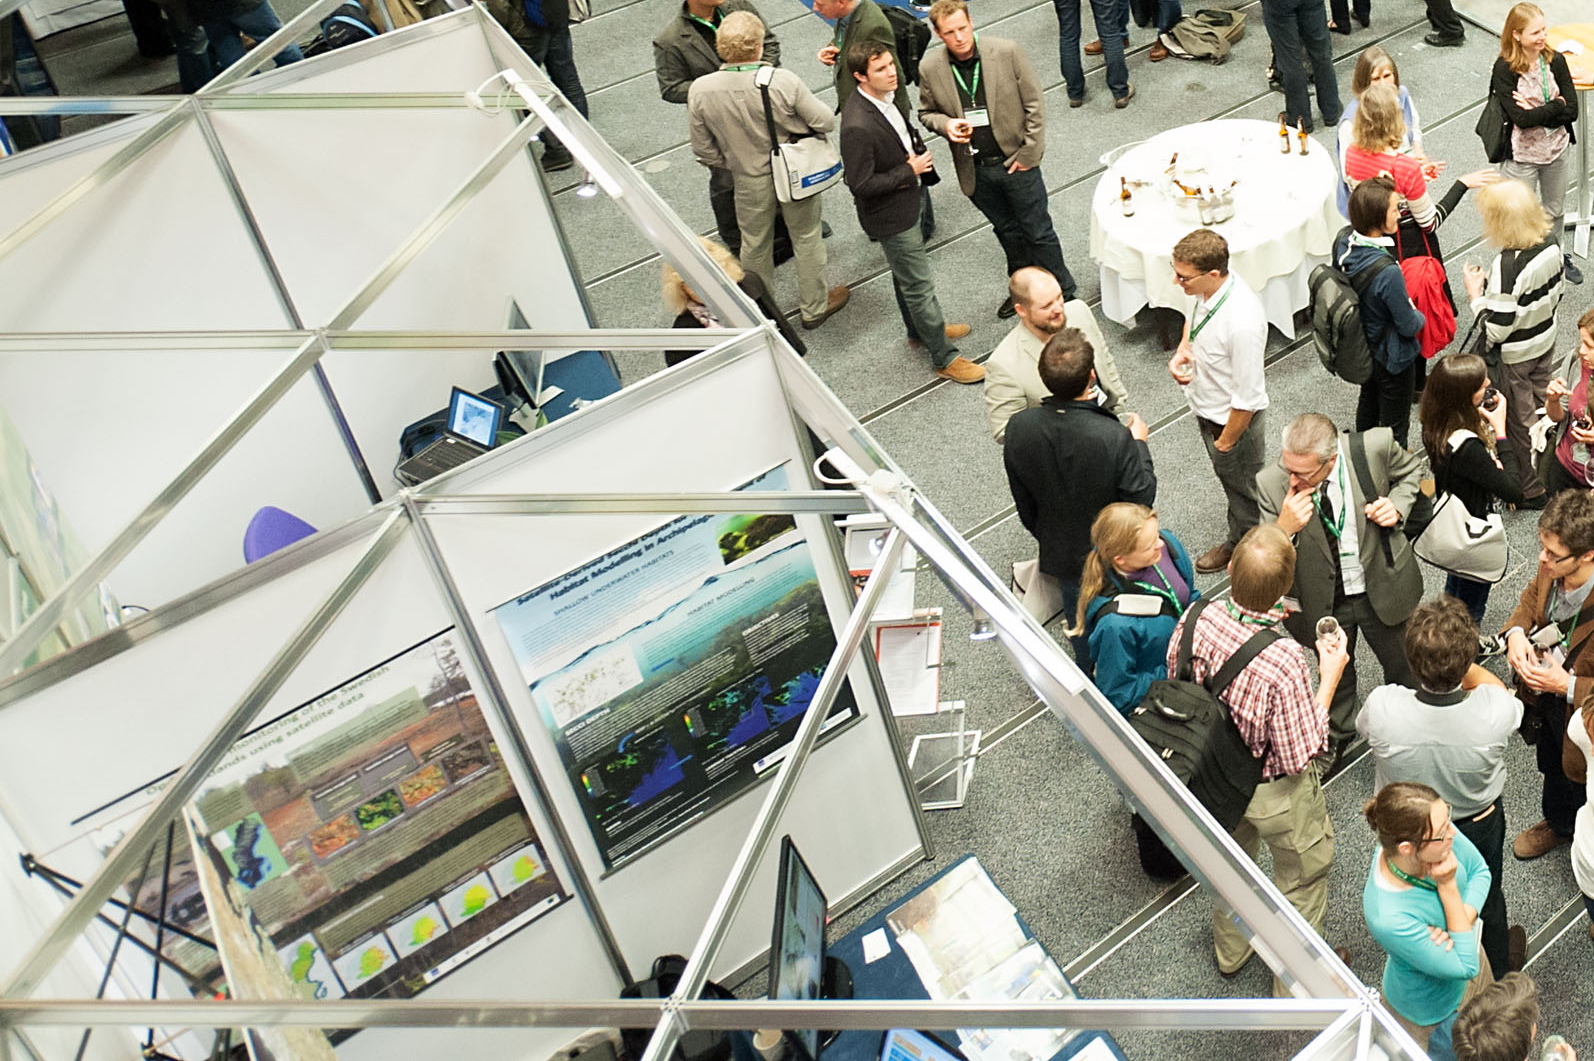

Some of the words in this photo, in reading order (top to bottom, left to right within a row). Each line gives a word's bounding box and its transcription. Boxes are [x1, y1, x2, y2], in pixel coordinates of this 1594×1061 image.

[549, 576, 589, 601] Habitat
[590, 549, 644, 579] Modelling
[644, 542, 655, 552] in
[553, 595, 589, 616] SHALLOW
[591, 568, 640, 596] UNDERWATER
[641, 549, 674, 570] HABITATS
[687, 599, 715, 617] HABITAT
[716, 577, 756, 601] MODELLING
[302, 703, 314, 716] of
[317, 693, 338, 707] the
[340, 665, 390, 695] Swedish
[249, 735, 284, 756] using
[286, 706, 335, 737] satellite
[337, 692, 365, 710] data
